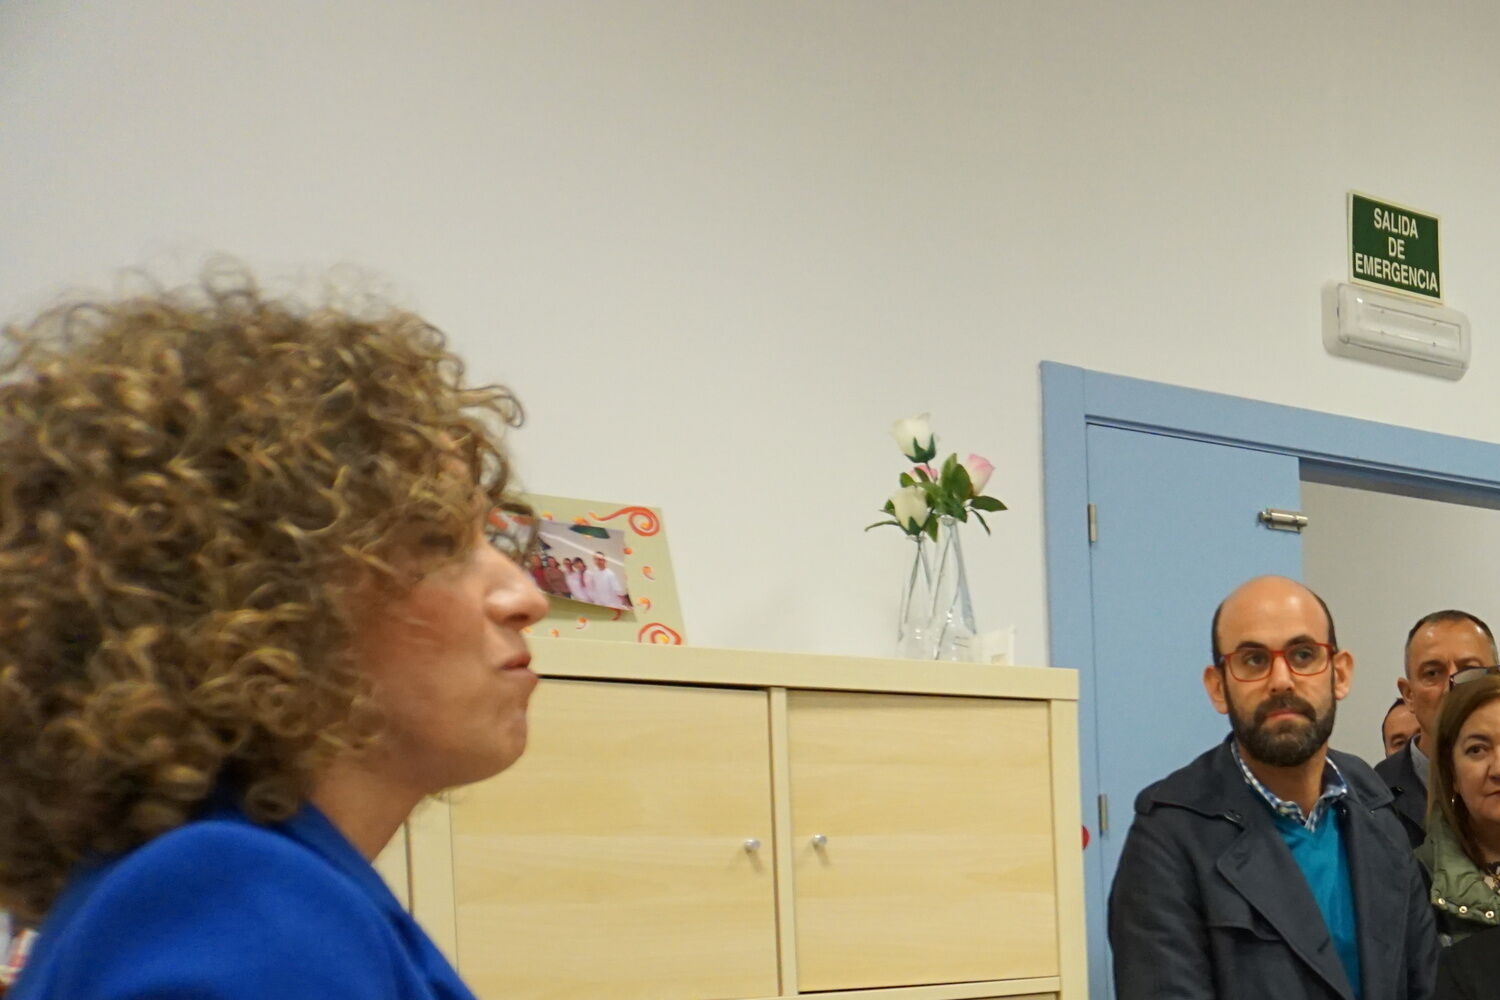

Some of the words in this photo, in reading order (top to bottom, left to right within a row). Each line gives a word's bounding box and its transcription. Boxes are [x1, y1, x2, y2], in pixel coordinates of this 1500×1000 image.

[1373, 207, 1419, 239] SALIDA
[1388, 236, 1406, 260] DE
[1355, 252, 1439, 293] EMERGENCIA
